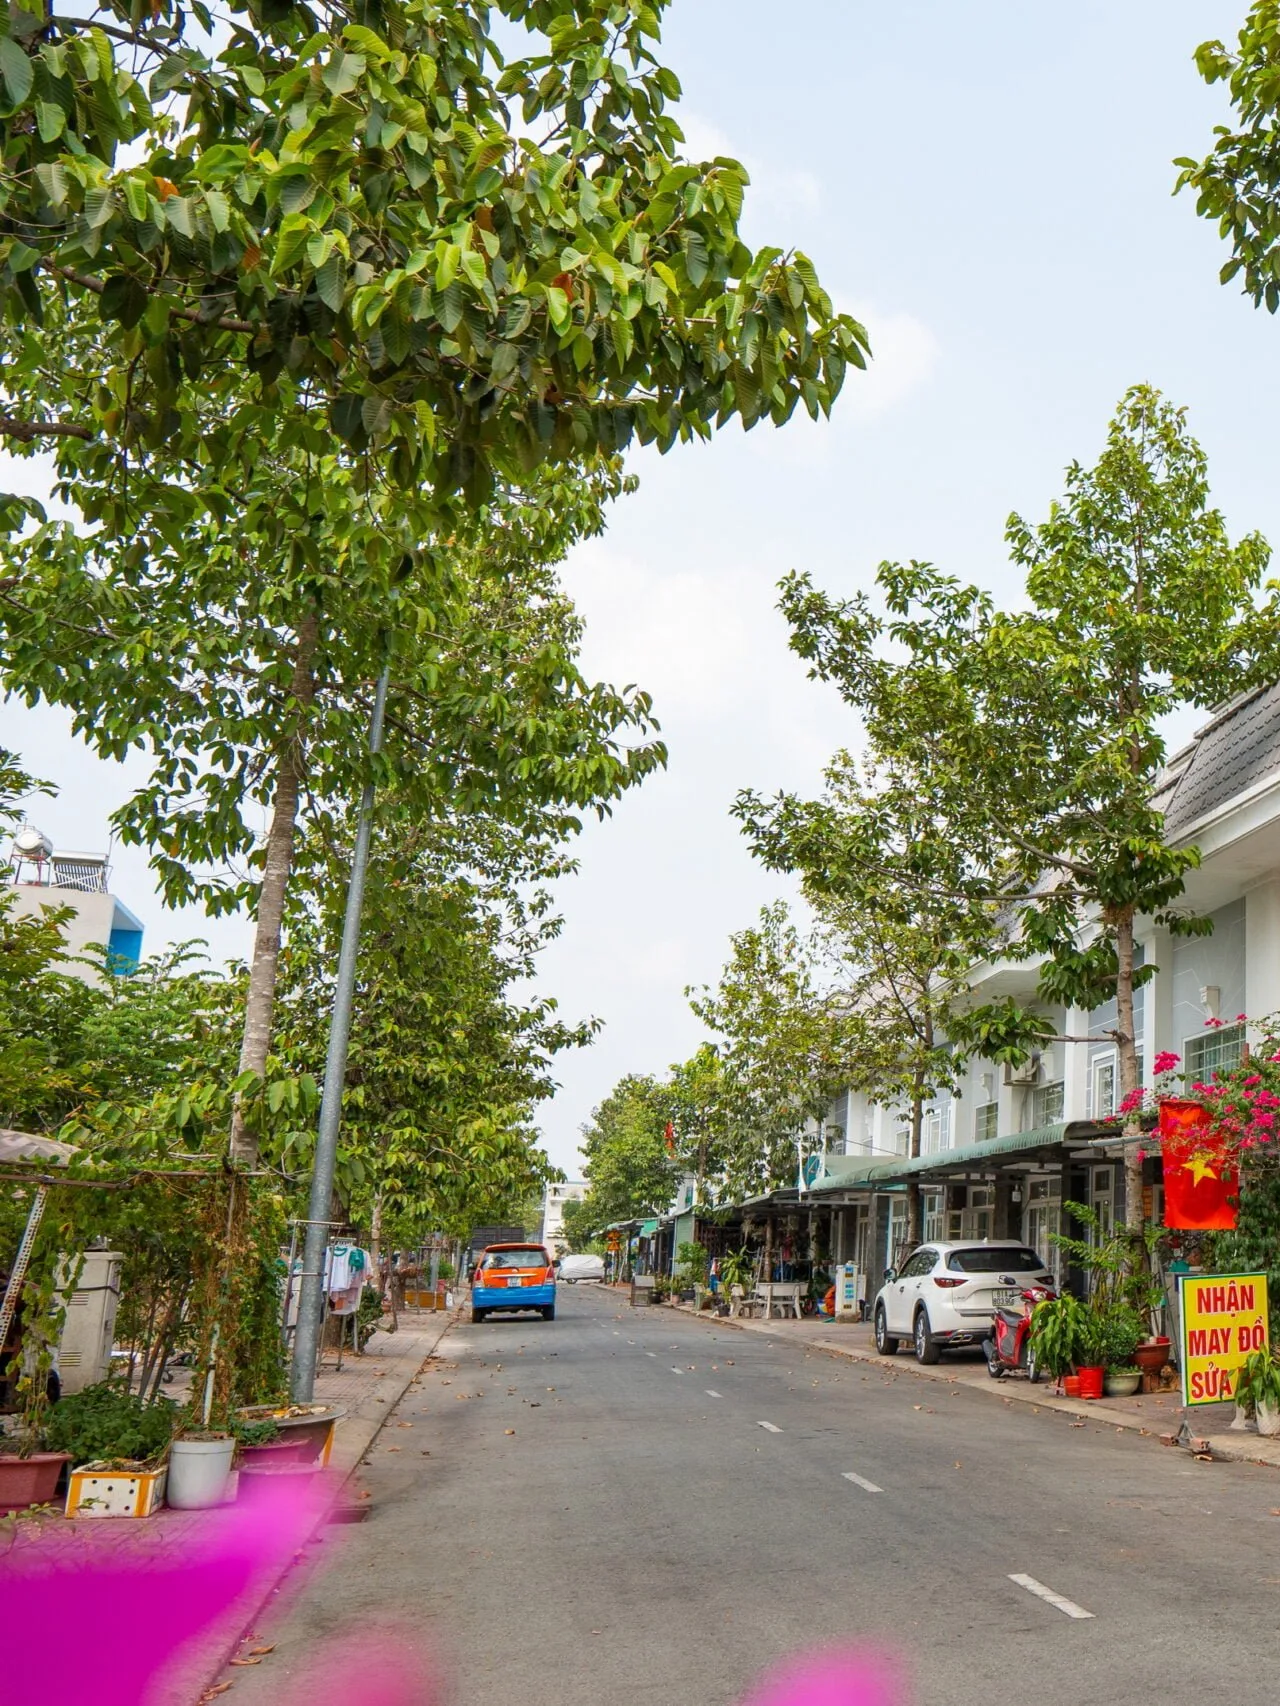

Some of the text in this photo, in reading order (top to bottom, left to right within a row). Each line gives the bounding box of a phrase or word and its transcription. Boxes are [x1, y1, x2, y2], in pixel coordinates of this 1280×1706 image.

[1197, 1280, 1254, 1317] NHẬN
[1189, 1328, 1231, 1356] MAY
[1191, 1361, 1232, 1398] SỬA
